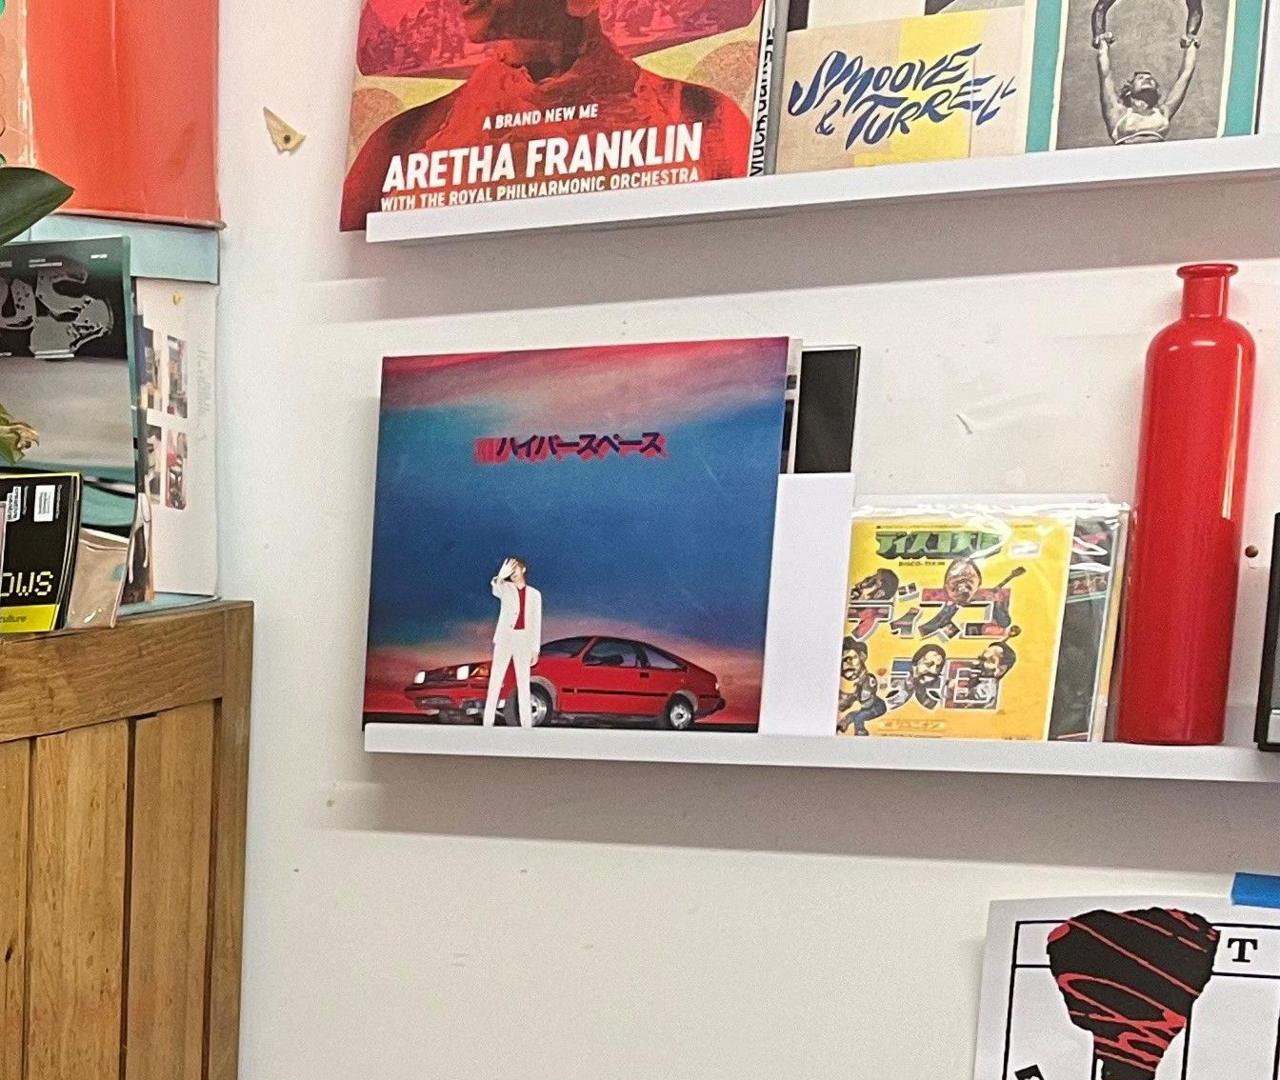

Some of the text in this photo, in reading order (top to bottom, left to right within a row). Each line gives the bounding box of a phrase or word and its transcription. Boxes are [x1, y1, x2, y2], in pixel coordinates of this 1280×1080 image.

[788, 43, 983, 117] SMOOVE
[482, 103, 599, 130] A BRAND NEW ME
[815, 75, 1017, 150] & TURRELL
[382, 122, 703, 193] ARETHA FRANKLIN
[381, 166, 699, 212] WITH THE ROYAL PHILHARMONIC ORCHESTRA
[1228, 938, 1258, 964] T
